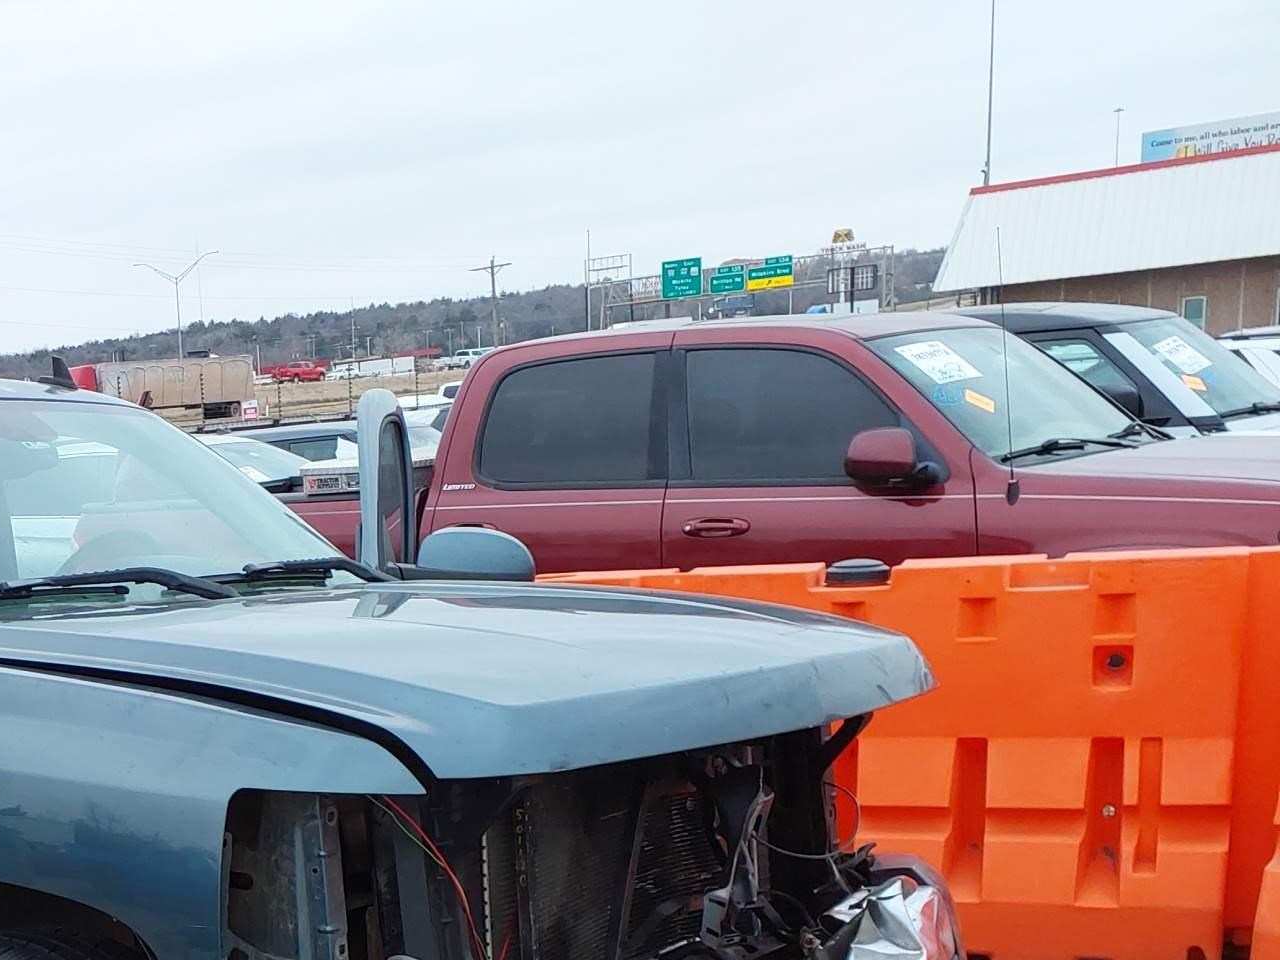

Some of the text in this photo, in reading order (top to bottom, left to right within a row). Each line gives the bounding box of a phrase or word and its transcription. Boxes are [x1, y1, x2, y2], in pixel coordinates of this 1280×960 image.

[1200, 132, 1210, 140] all
[1230, 126, 1251, 136] labor
[1253, 122, 1269, 132] and
[442, 483, 476, 491] LIMITED
